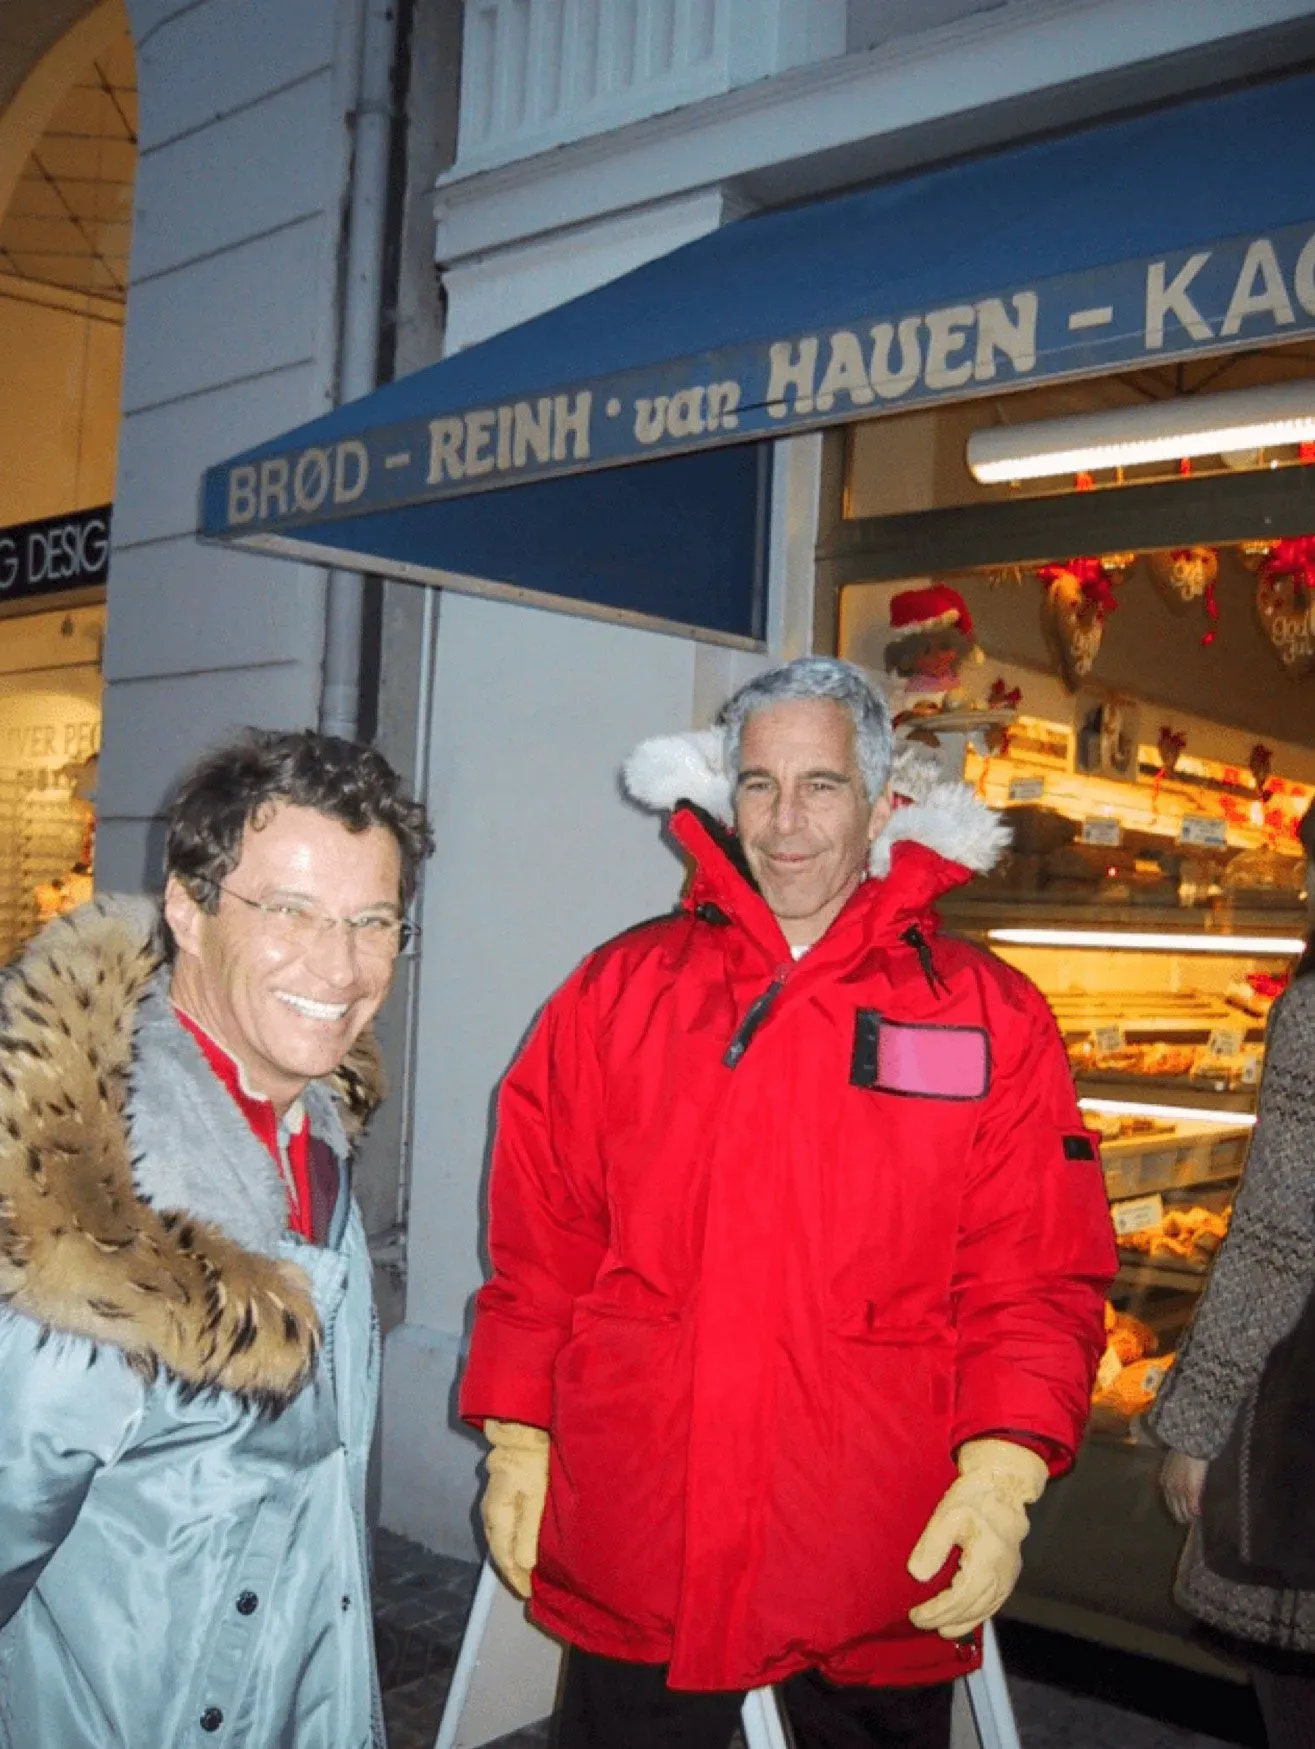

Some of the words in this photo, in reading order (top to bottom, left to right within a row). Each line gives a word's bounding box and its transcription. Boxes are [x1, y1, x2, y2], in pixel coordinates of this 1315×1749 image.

[228, 440, 369, 525] BRØD
[426, 390, 593, 485] REINH
[634, 380, 741, 444] van
[28, 519, 108, 583] DESIG
